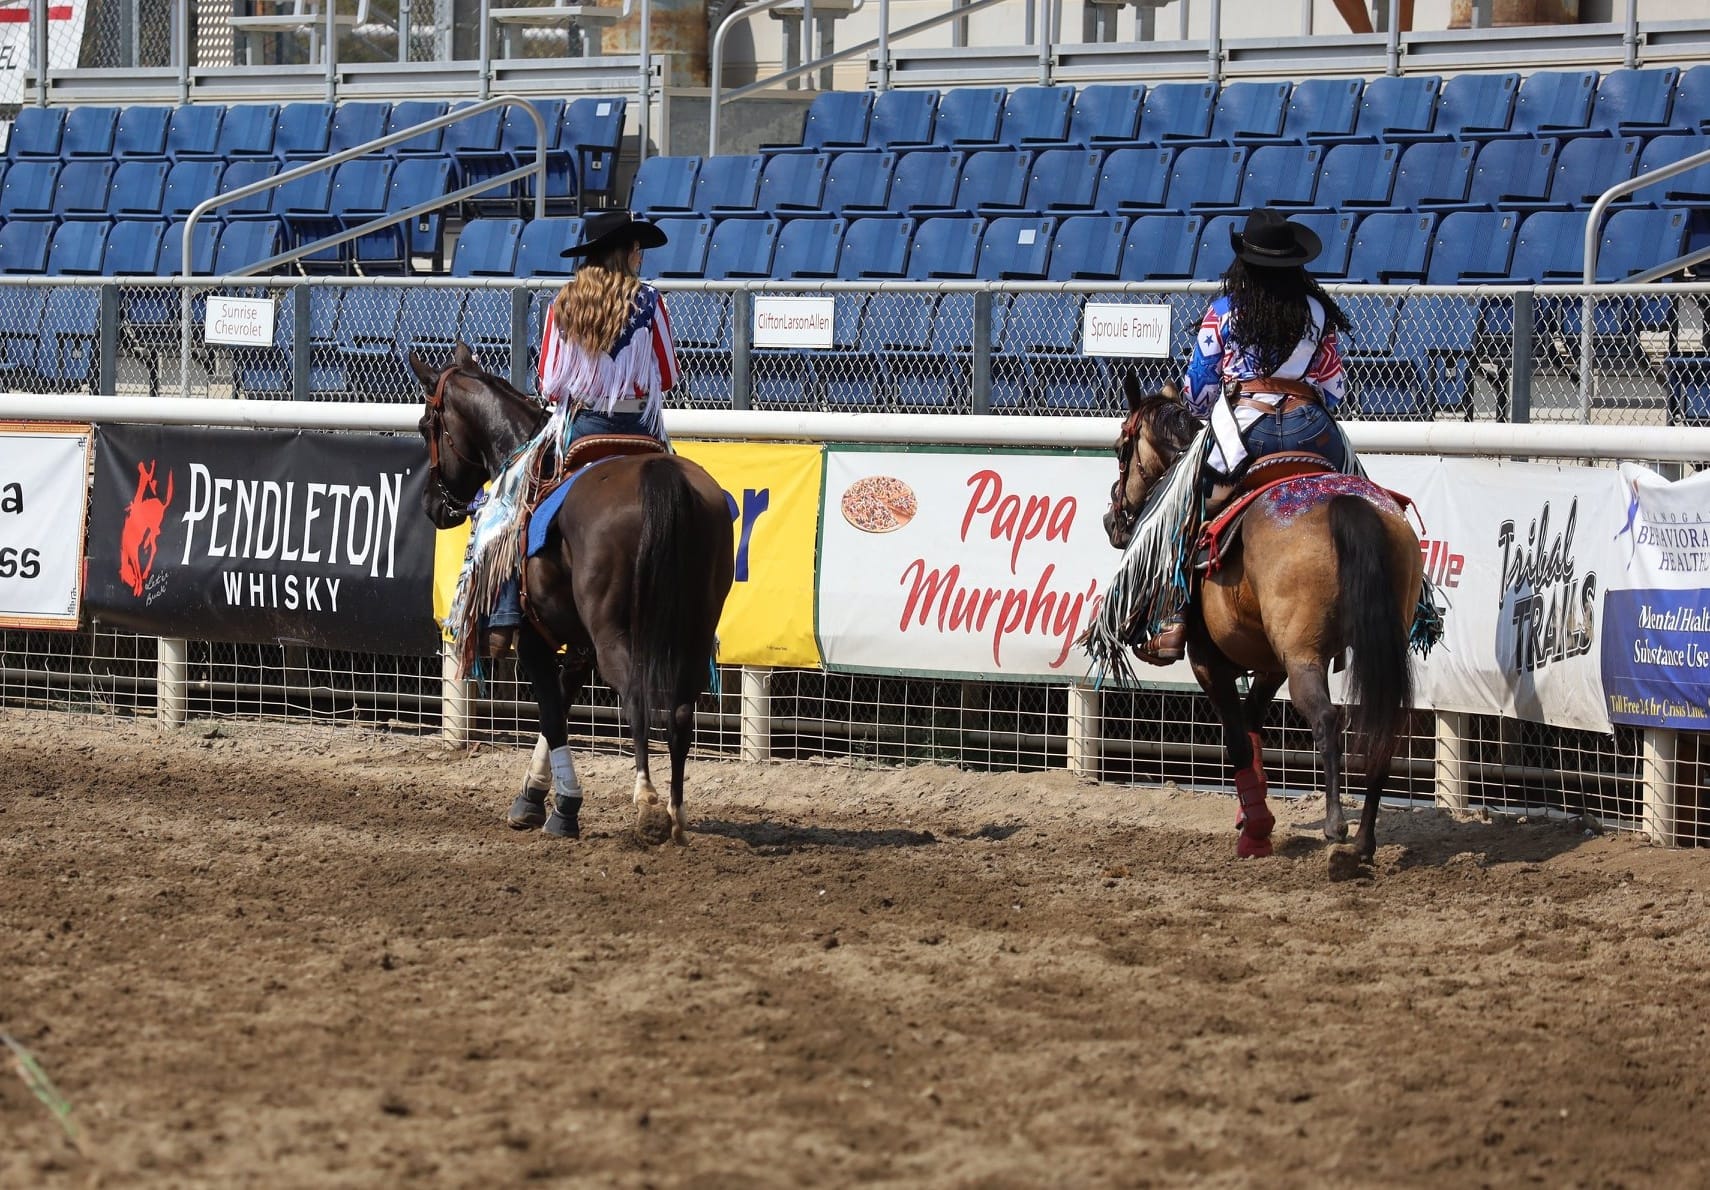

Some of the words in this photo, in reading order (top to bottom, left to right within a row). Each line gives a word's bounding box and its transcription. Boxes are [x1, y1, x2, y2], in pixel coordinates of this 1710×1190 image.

[222, 303, 257, 320] Sunrise
[758, 312, 830, 330] CliftonLarsonAllen
[215, 320, 262, 337] Chevrolet
[1091, 316, 1129, 342] Sproule
[1132, 317, 1163, 344] Family
[181, 463, 403, 579] PENDLETON
[960, 469, 1077, 575] Papa
[1498, 495, 1577, 610] Tribal
[223, 570, 341, 613] WHISKY
[1513, 571, 1597, 676] TRAILS
[1638, 605, 1683, 631] Mental
[1680, 606, 1710, 632] Healt
[1634, 639, 1684, 666] Substance
[1687, 643, 1709, 668] Use
[1623, 696, 1640, 714] Free
[1650, 697, 1662, 716] hr
[1662, 698, 1686, 717] Crisis
